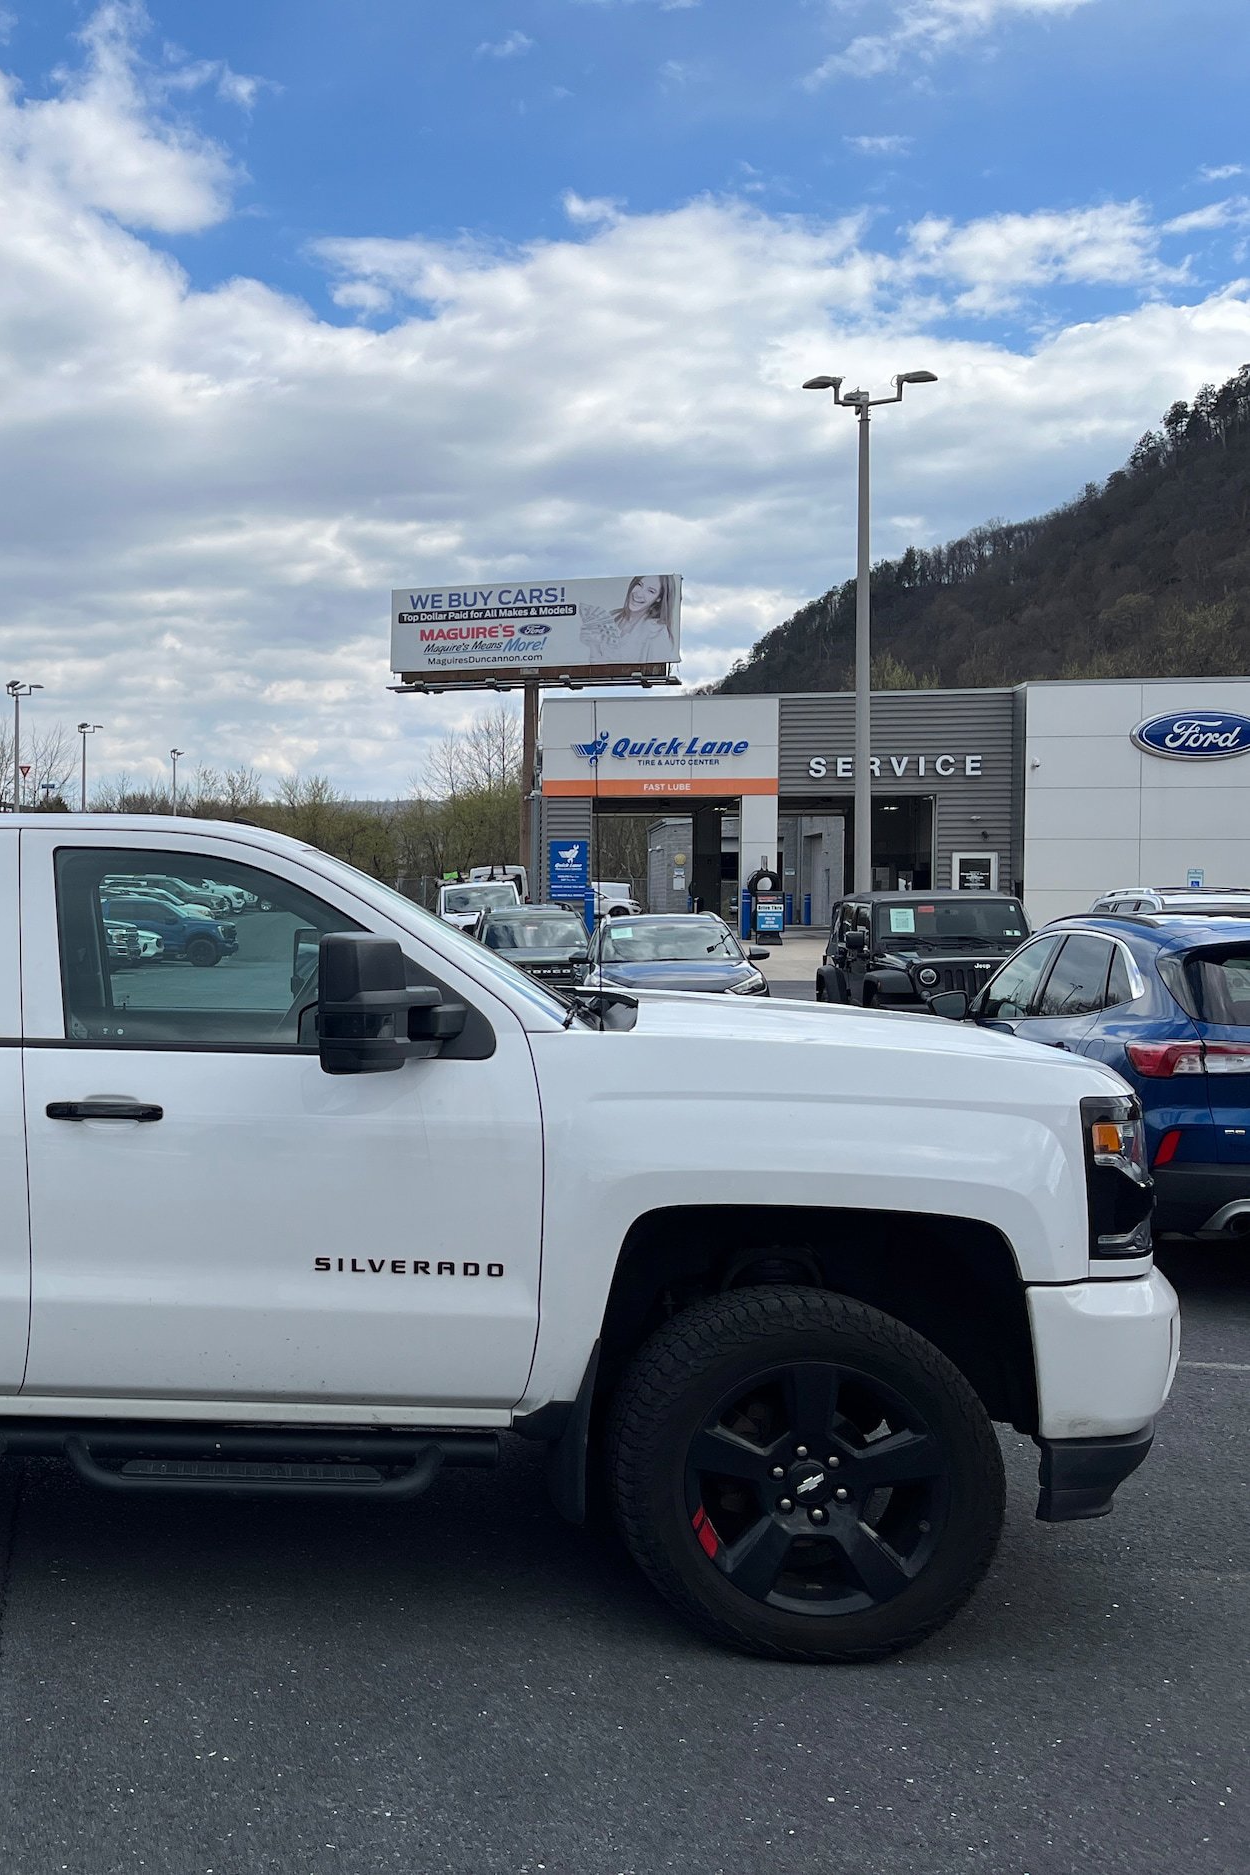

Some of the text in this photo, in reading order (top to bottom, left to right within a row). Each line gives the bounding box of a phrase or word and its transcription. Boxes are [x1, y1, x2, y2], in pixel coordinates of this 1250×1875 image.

[410, 587, 565, 610] WE BUY CARS!
[402, 605, 573, 623] Top Dollar Paid for All Makes & Models
[420, 624, 515, 641] MAGUIRE'S
[423, 636, 547, 655] Maguire's Means More!
[428, 654, 543, 667] MaguiresDuncannon.com
[1165, 720, 1241, 748] Ford
[611, 737, 749, 759] Quick Lane
[808, 754, 982, 778] SERVICE
[643, 783, 691, 791] FAST LUBE
[314, 1257, 504, 1277] SILVERADO
